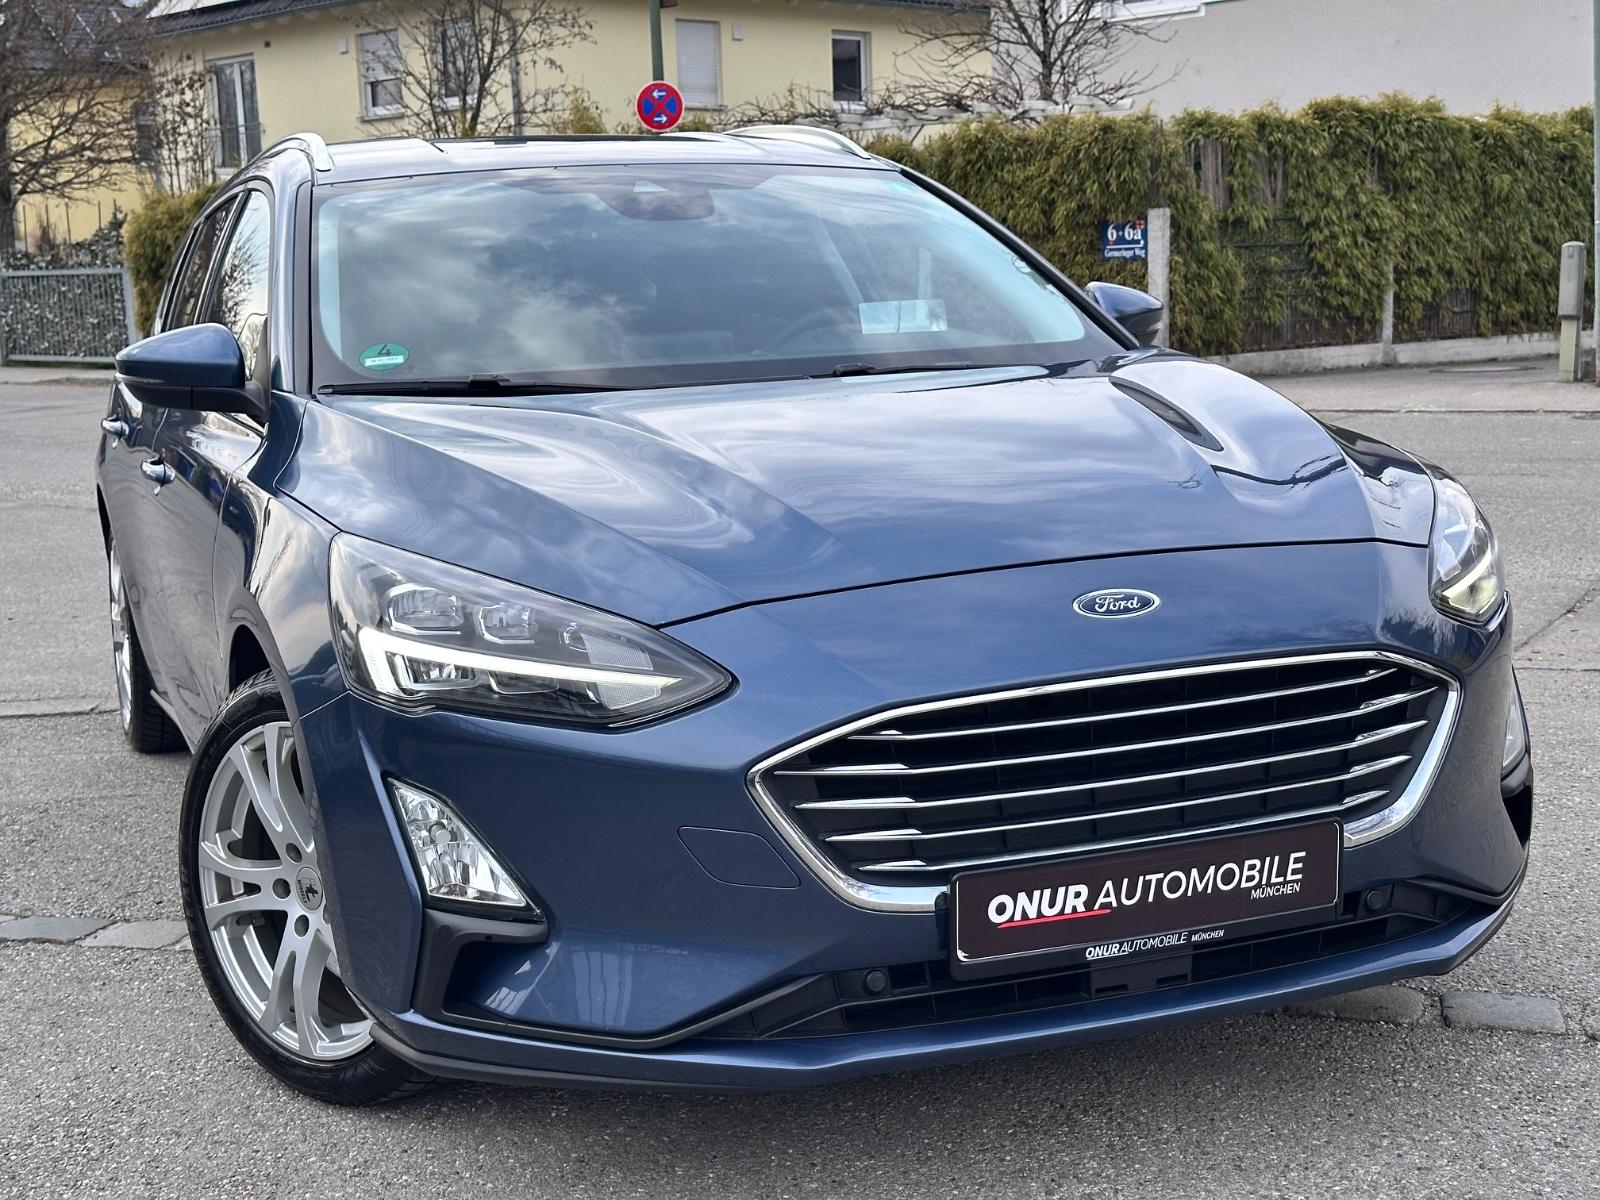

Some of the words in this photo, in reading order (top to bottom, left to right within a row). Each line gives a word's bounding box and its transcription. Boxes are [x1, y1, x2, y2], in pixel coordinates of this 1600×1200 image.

[377, 343, 393, 356] 4
[1094, 594, 1141, 612] Ford
[987, 884, 1089, 924] ONUR
[1093, 851, 1307, 911] AUTOMOBILE
[1250, 882, 1301, 900] MÜNCHEN
[1085, 943, 1120, 958] ONUR
[1120, 932, 1189, 953] AUTOMOBILE
[1191, 929, 1225, 942] MÜNCHEN
